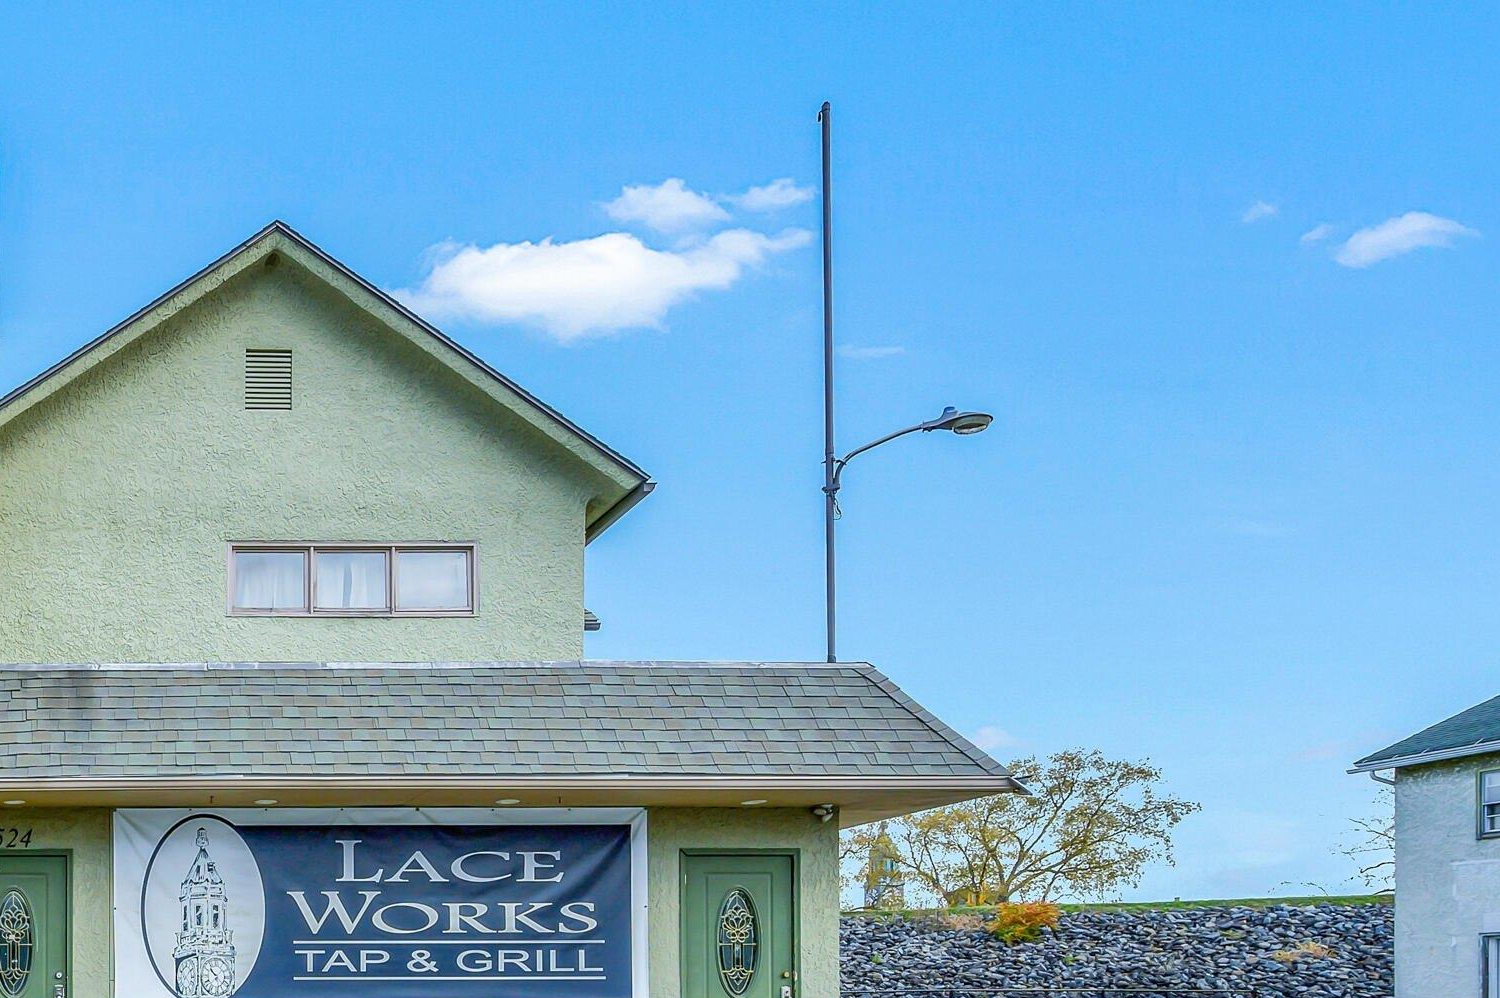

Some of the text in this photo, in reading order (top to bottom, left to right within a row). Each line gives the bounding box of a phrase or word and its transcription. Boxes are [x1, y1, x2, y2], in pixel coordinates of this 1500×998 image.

[334, 839, 565, 883] LACE
[287, 890, 599, 935] WORKS
[294, 949, 604, 973] TAP & GRILL
